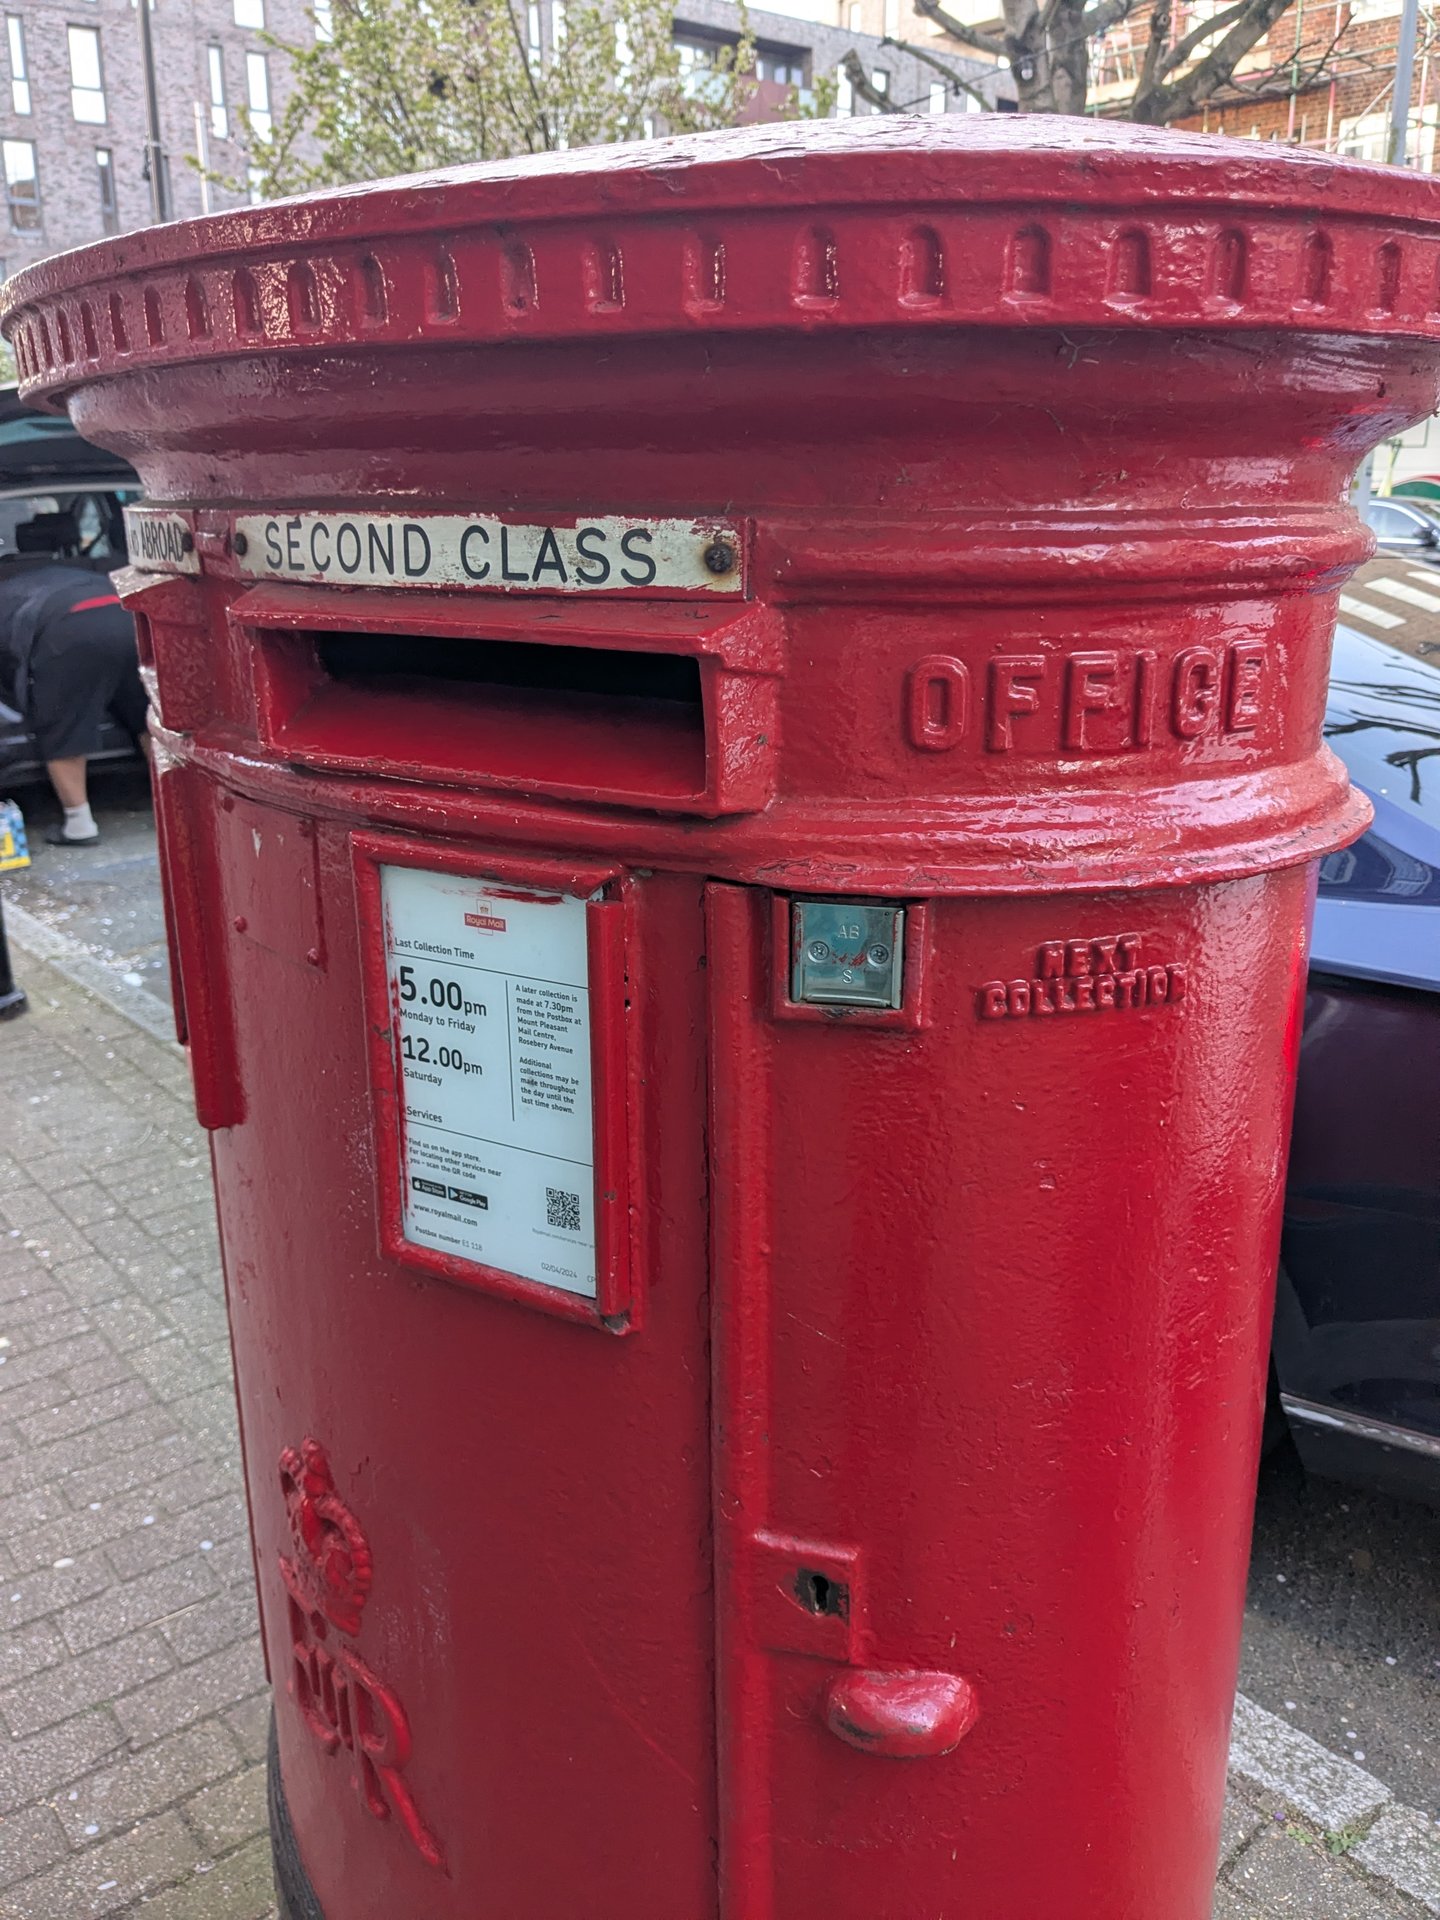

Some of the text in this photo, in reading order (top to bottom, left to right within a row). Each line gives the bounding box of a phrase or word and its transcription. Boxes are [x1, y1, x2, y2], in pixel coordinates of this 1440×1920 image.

[140, 521, 184, 562] ABROAD
[265, 521, 657, 586] SECOND CLASS
[908, 638, 1268, 752] OFFICE
[466, 915, 504, 929] Royal Mail
[838, 924, 860, 940] AB
[394, 937, 475, 960] Last Collection Time
[1038, 931, 1142, 977] NEXT
[842, 969, 853, 984] S
[399, 965, 487, 1016] 5.00pm
[515, 984, 578, 1002] A later collection is
[516, 997, 534, 1006] made
[544, 1000, 574, 1013] 7.30pm
[399, 1007, 476, 1034] Monday to Friday
[516, 1006, 533, 1015] from
[534, 1010, 545, 1018] the
[546, 1012, 573, 1024] Postbox
[517, 1016, 568, 1033] Mount Pleasant
[517, 1026, 557, 1041] Mail Centre,
[401, 1034, 483, 1075] 12.00pm
[518, 1036, 574, 1054] Rosebery Avenue
[519, 1056, 552, 1070] Additional
[403, 1067, 443, 1087] Saturday
[519, 1067, 580, 1086] collections may be
[520, 1077, 577, 1095] made throughout
[520, 1086, 575, 1105] the day until the
[406, 1105, 443, 1123] Services
[521, 1096, 575, 1115] last time shown.
[408, 1137, 421, 1147] Find
[439, 1146, 450, 1154] the
[451, 1150, 462, 1158] app
[409, 1146, 502, 1177] For locating other services near
[410, 1157, 420, 1165] you
[426, 1160, 440, 1169] scan
[440, 1165, 451, 1173] the
[451, 1167, 461, 1176] QR
[462, 1170, 476, 1180] code
[413, 1203, 478, 1227] www.royalmail.com
[414, 1225, 437, 1238] Postbox
[438, 1233, 461, 1245] number
